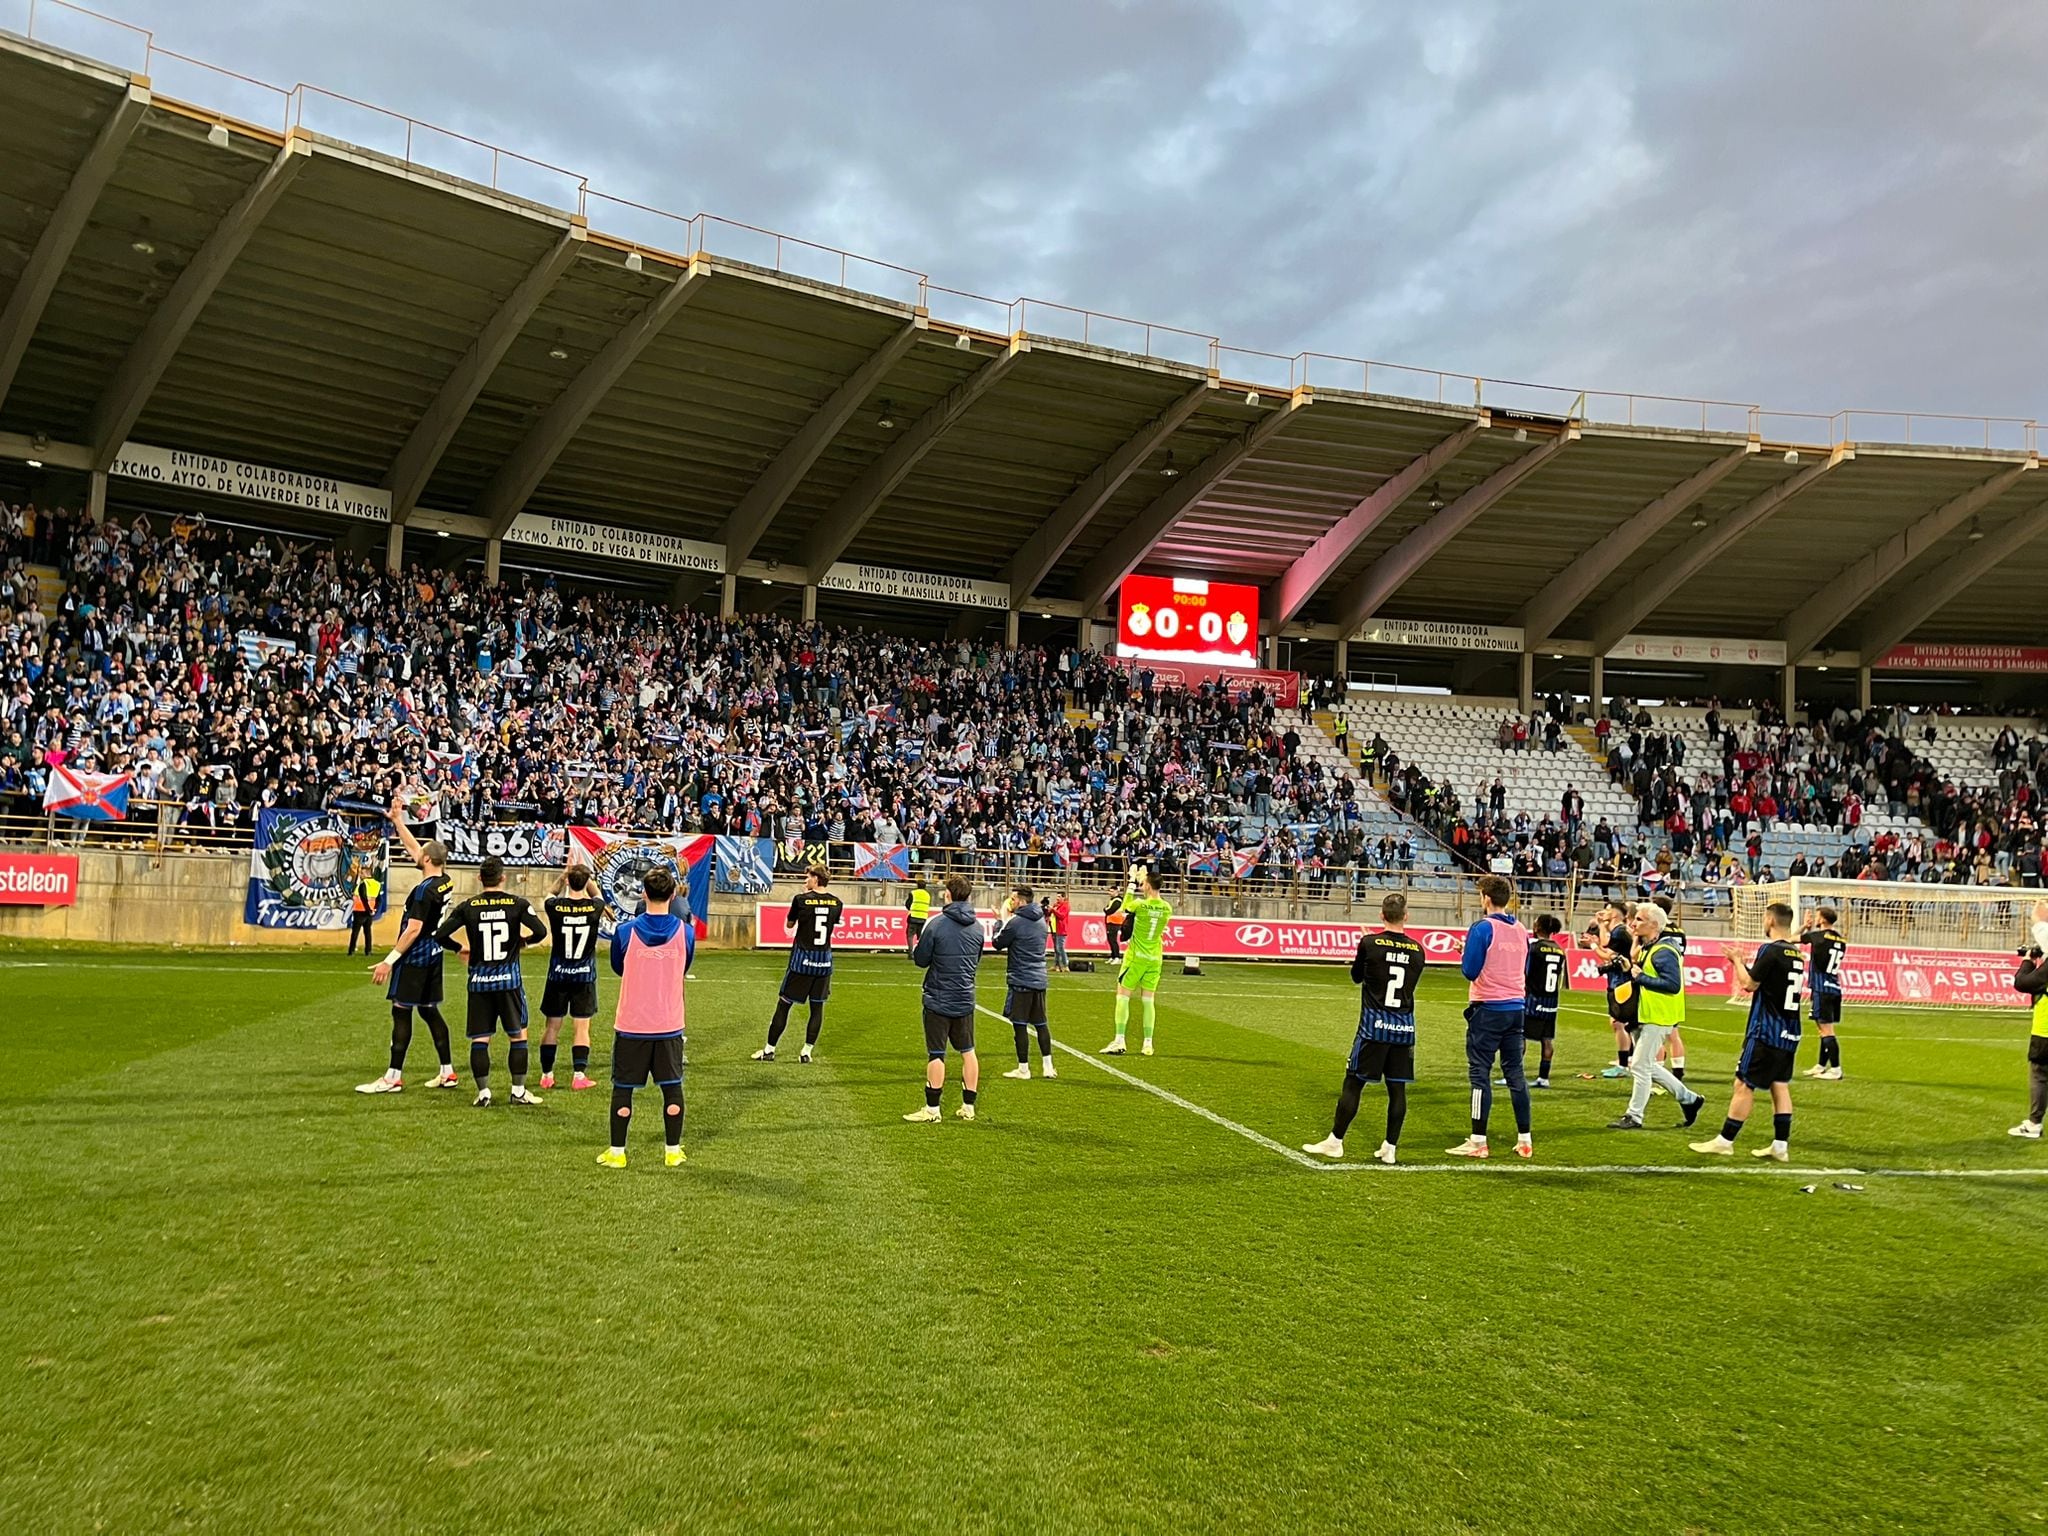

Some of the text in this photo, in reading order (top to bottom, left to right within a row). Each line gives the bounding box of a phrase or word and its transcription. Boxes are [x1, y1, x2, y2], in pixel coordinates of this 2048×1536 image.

[171, 451, 338, 495] ENTIDAD COLABORADORA
[112, 459, 388, 521] EXCMO. AYTO. DE VALVERDE DE LA VIRGEN
[551, 519, 683, 551] ENTIDAD COLABORADORA
[511, 528, 719, 571] EXCMO. AYTO. DE VEGA DE INFANZONES
[820, 576, 1008, 608] EXCMO. AYTO. DE MANSILLA DE LAS MULAS
[859, 566, 973, 590] ENTIDAD COLABORADORA
[1173, 594, 1207, 607] 90:00
[1155, 608, 1179, 638] 0
[1199, 612, 1222, 642] 0
[1384, 620, 1489, 636] ENTIDAD COLABORADORA
[1461, 638, 1471, 648] DE
[1474, 638, 1519, 651] ONZONILLA
[1914, 647, 2022, 658] ENTIDAD COLABORADORA
[1924, 658, 1990, 669] AYUNTAMIENTO
[1993, 659, 2003, 669] DE
[435, 821, 479, 855] FN
[487, 830, 530, 857] 86
[0, 865, 69, 893] steleón
[813, 915, 828, 945] 5
[831, 931, 892, 940] ACADEMY
[833, 914, 903, 931] SPIRE
[1147, 917, 1159, 941] 1
[478, 921, 509, 961] 12
[561, 925, 591, 959] 17
[1278, 928, 1363, 948] HYUNDA
[1384, 965, 1406, 1008] 2
[1545, 963, 1558, 993] 6
[1934, 970, 2014, 990] ASPIR
[1951, 991, 2027, 1003] ACADEMY
